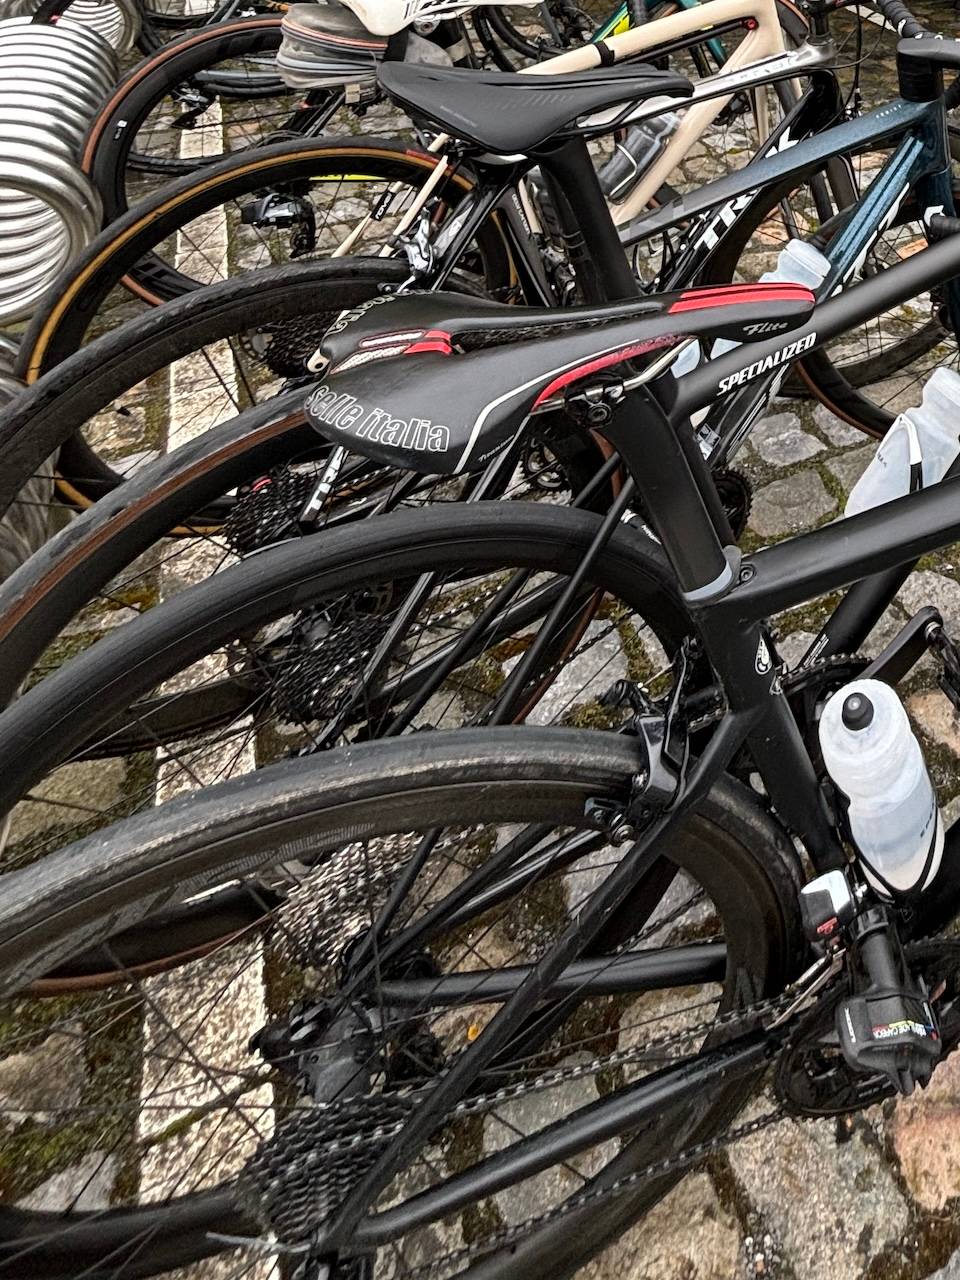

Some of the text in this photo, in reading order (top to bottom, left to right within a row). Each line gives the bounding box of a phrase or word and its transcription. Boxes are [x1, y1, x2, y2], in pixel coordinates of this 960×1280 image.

[693, 126, 800, 251] TRK
[742, 322, 788, 336] Flite
[716, 332, 817, 397] SPECIALIZED
[304, 384, 364, 430] selle
[356, 408, 450, 453] italia
